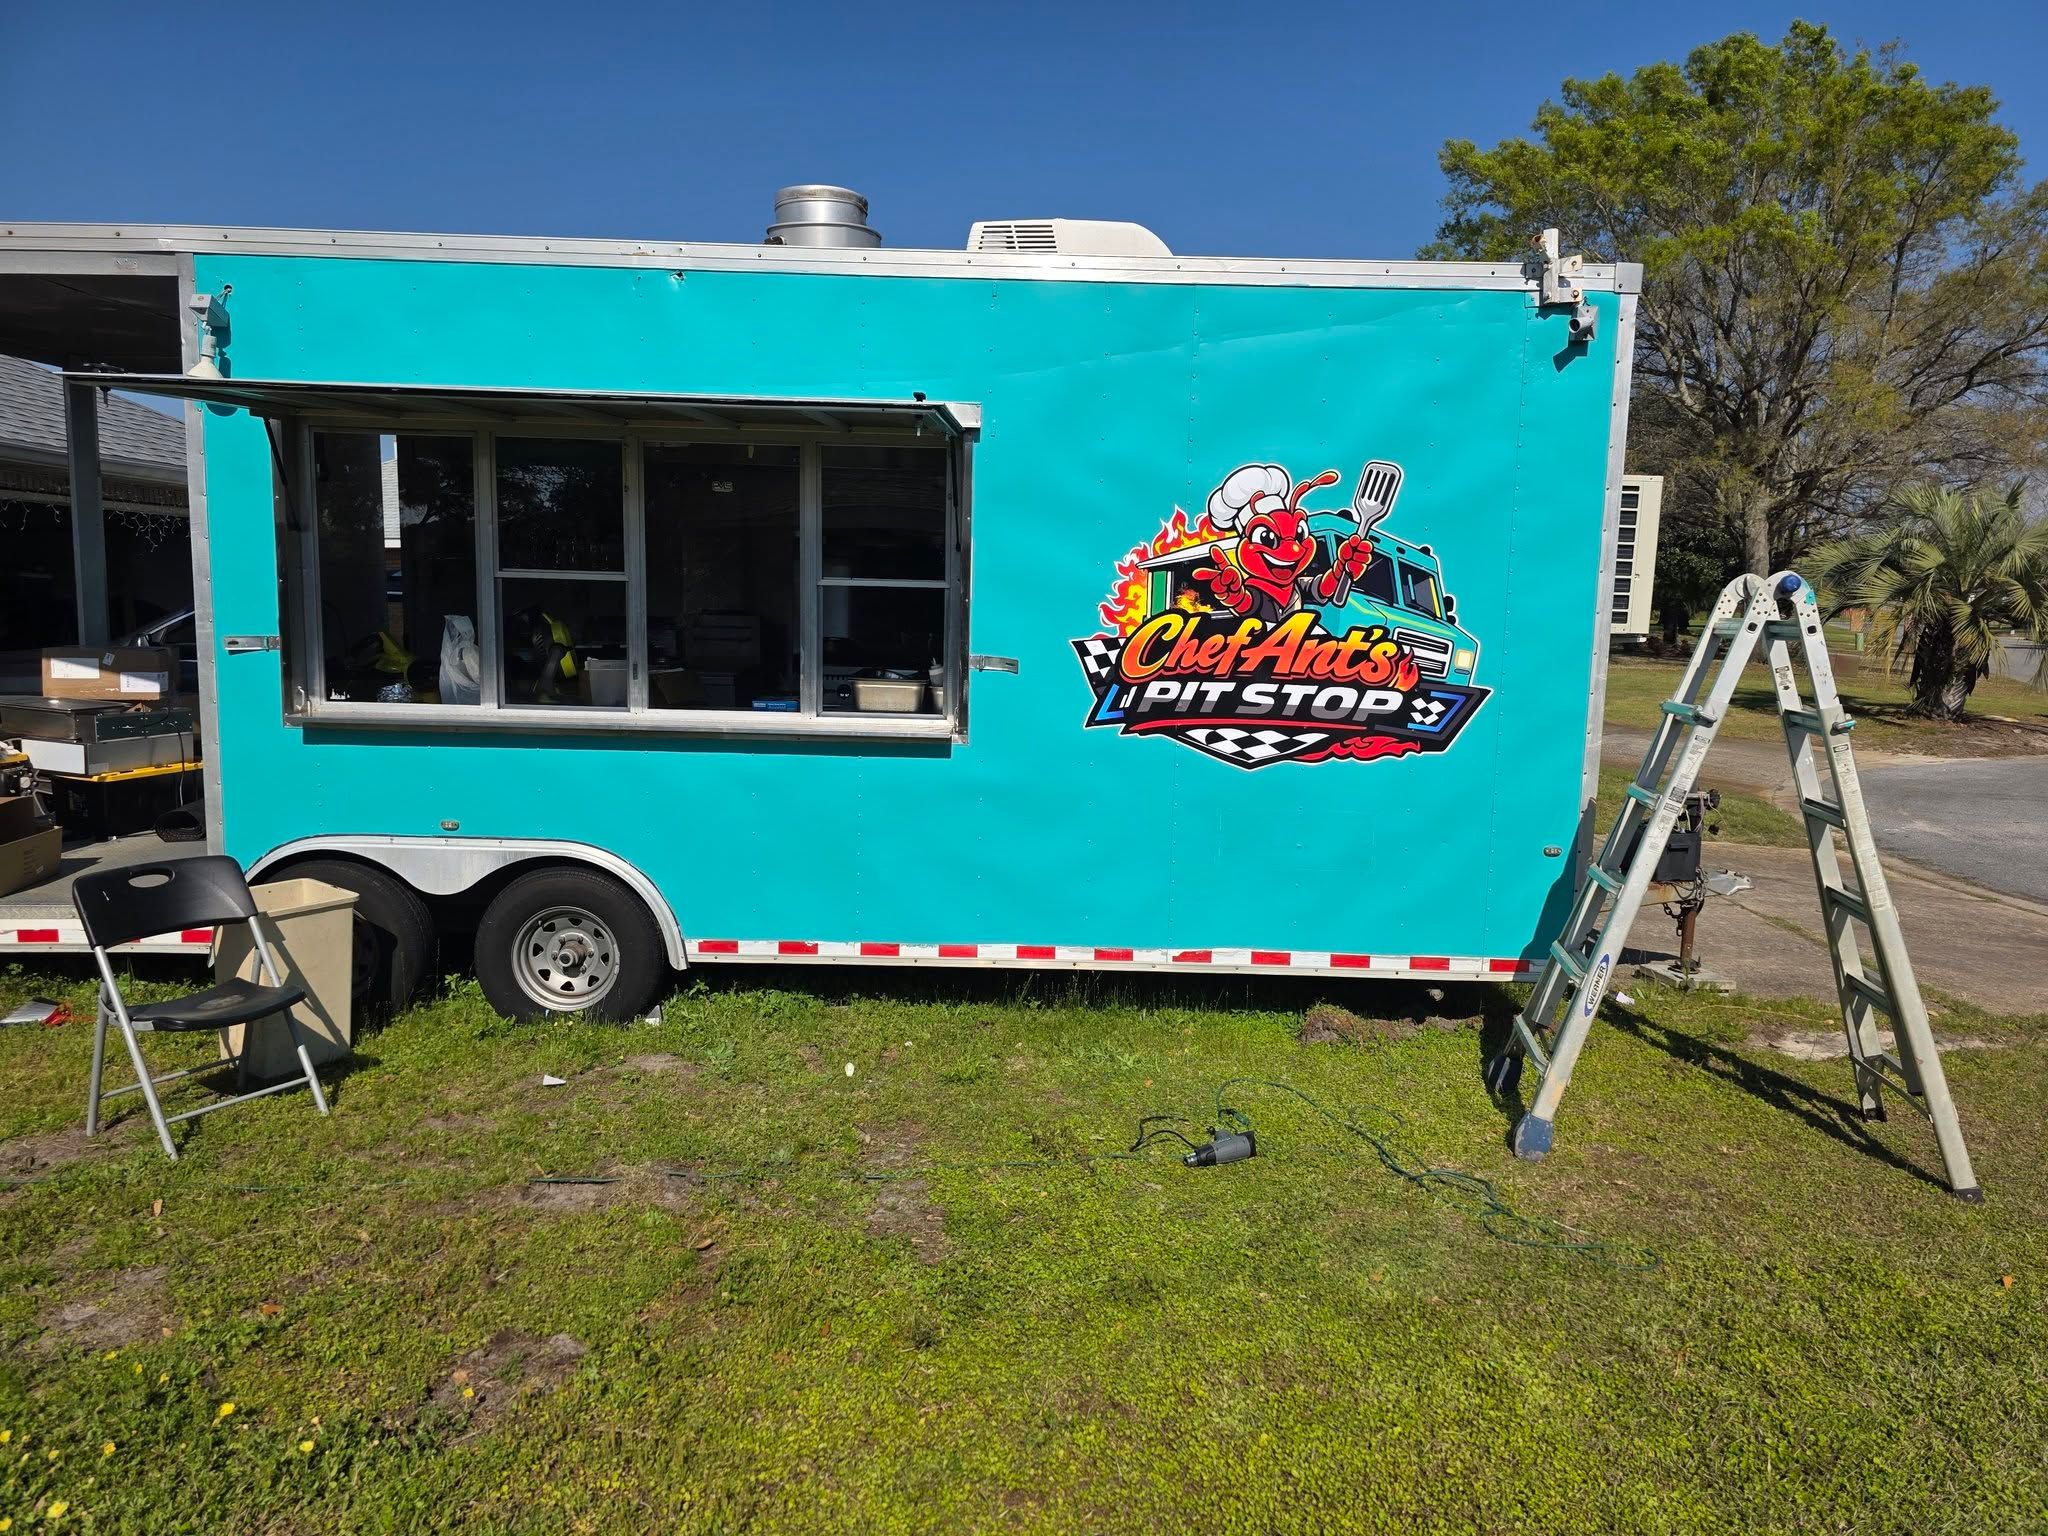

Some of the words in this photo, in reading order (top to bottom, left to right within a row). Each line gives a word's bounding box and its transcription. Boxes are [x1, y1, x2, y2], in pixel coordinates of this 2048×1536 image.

[1120, 613, 1261, 681] Chef
[1237, 612, 1400, 685] Ant's
[1137, 680, 1237, 714] PIT
[1238, 681, 1405, 723] STOP
[1588, 965, 1606, 1005] WERNER
